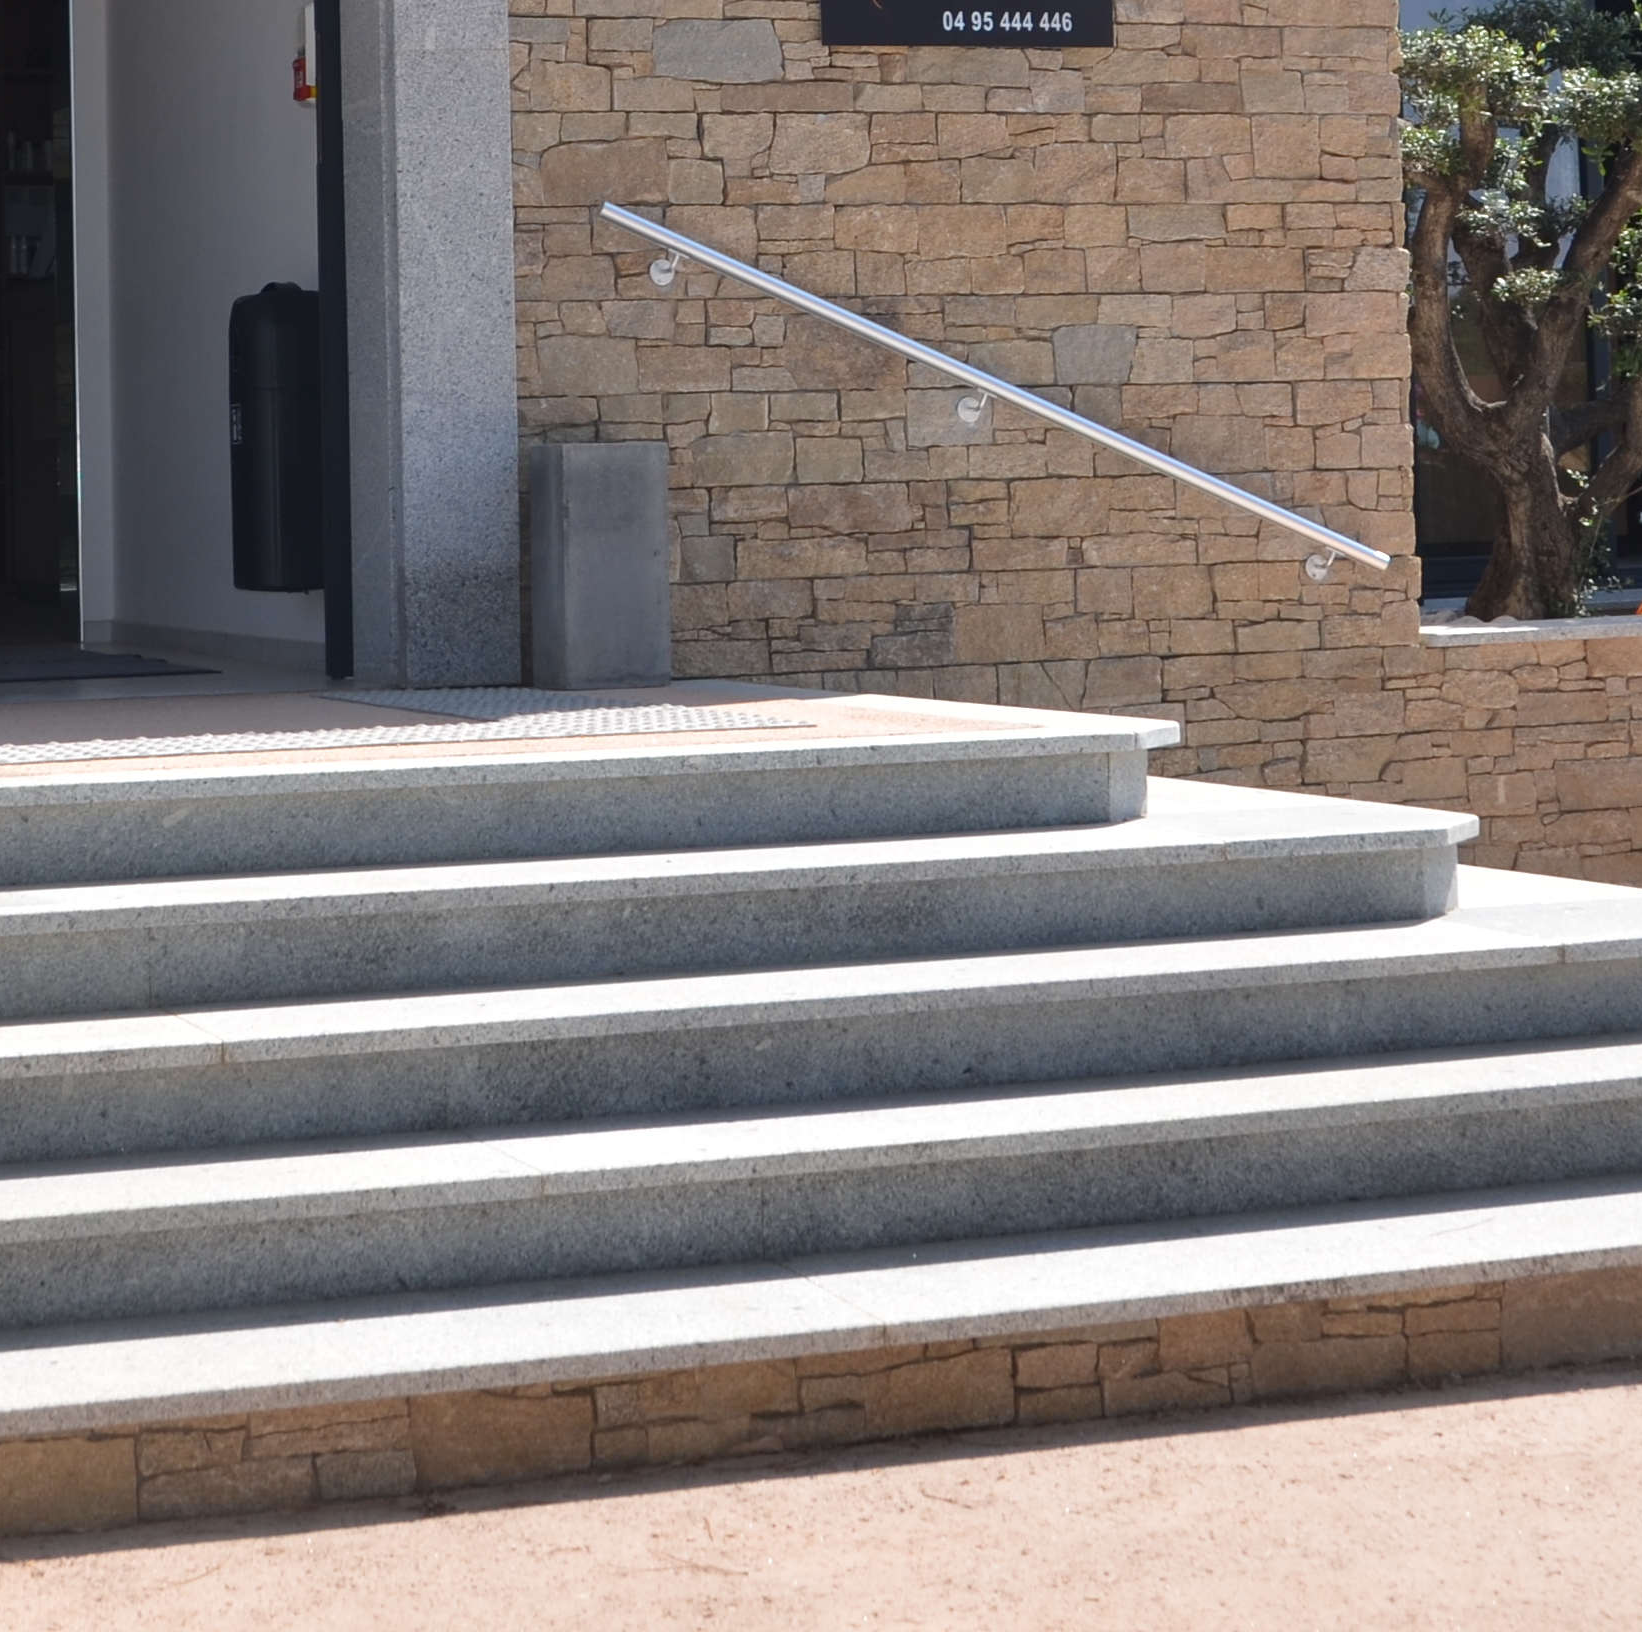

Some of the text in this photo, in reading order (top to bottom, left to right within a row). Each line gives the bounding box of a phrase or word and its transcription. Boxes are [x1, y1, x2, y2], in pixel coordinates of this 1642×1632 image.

[942, 10, 1073, 32] 04 95 444 446
